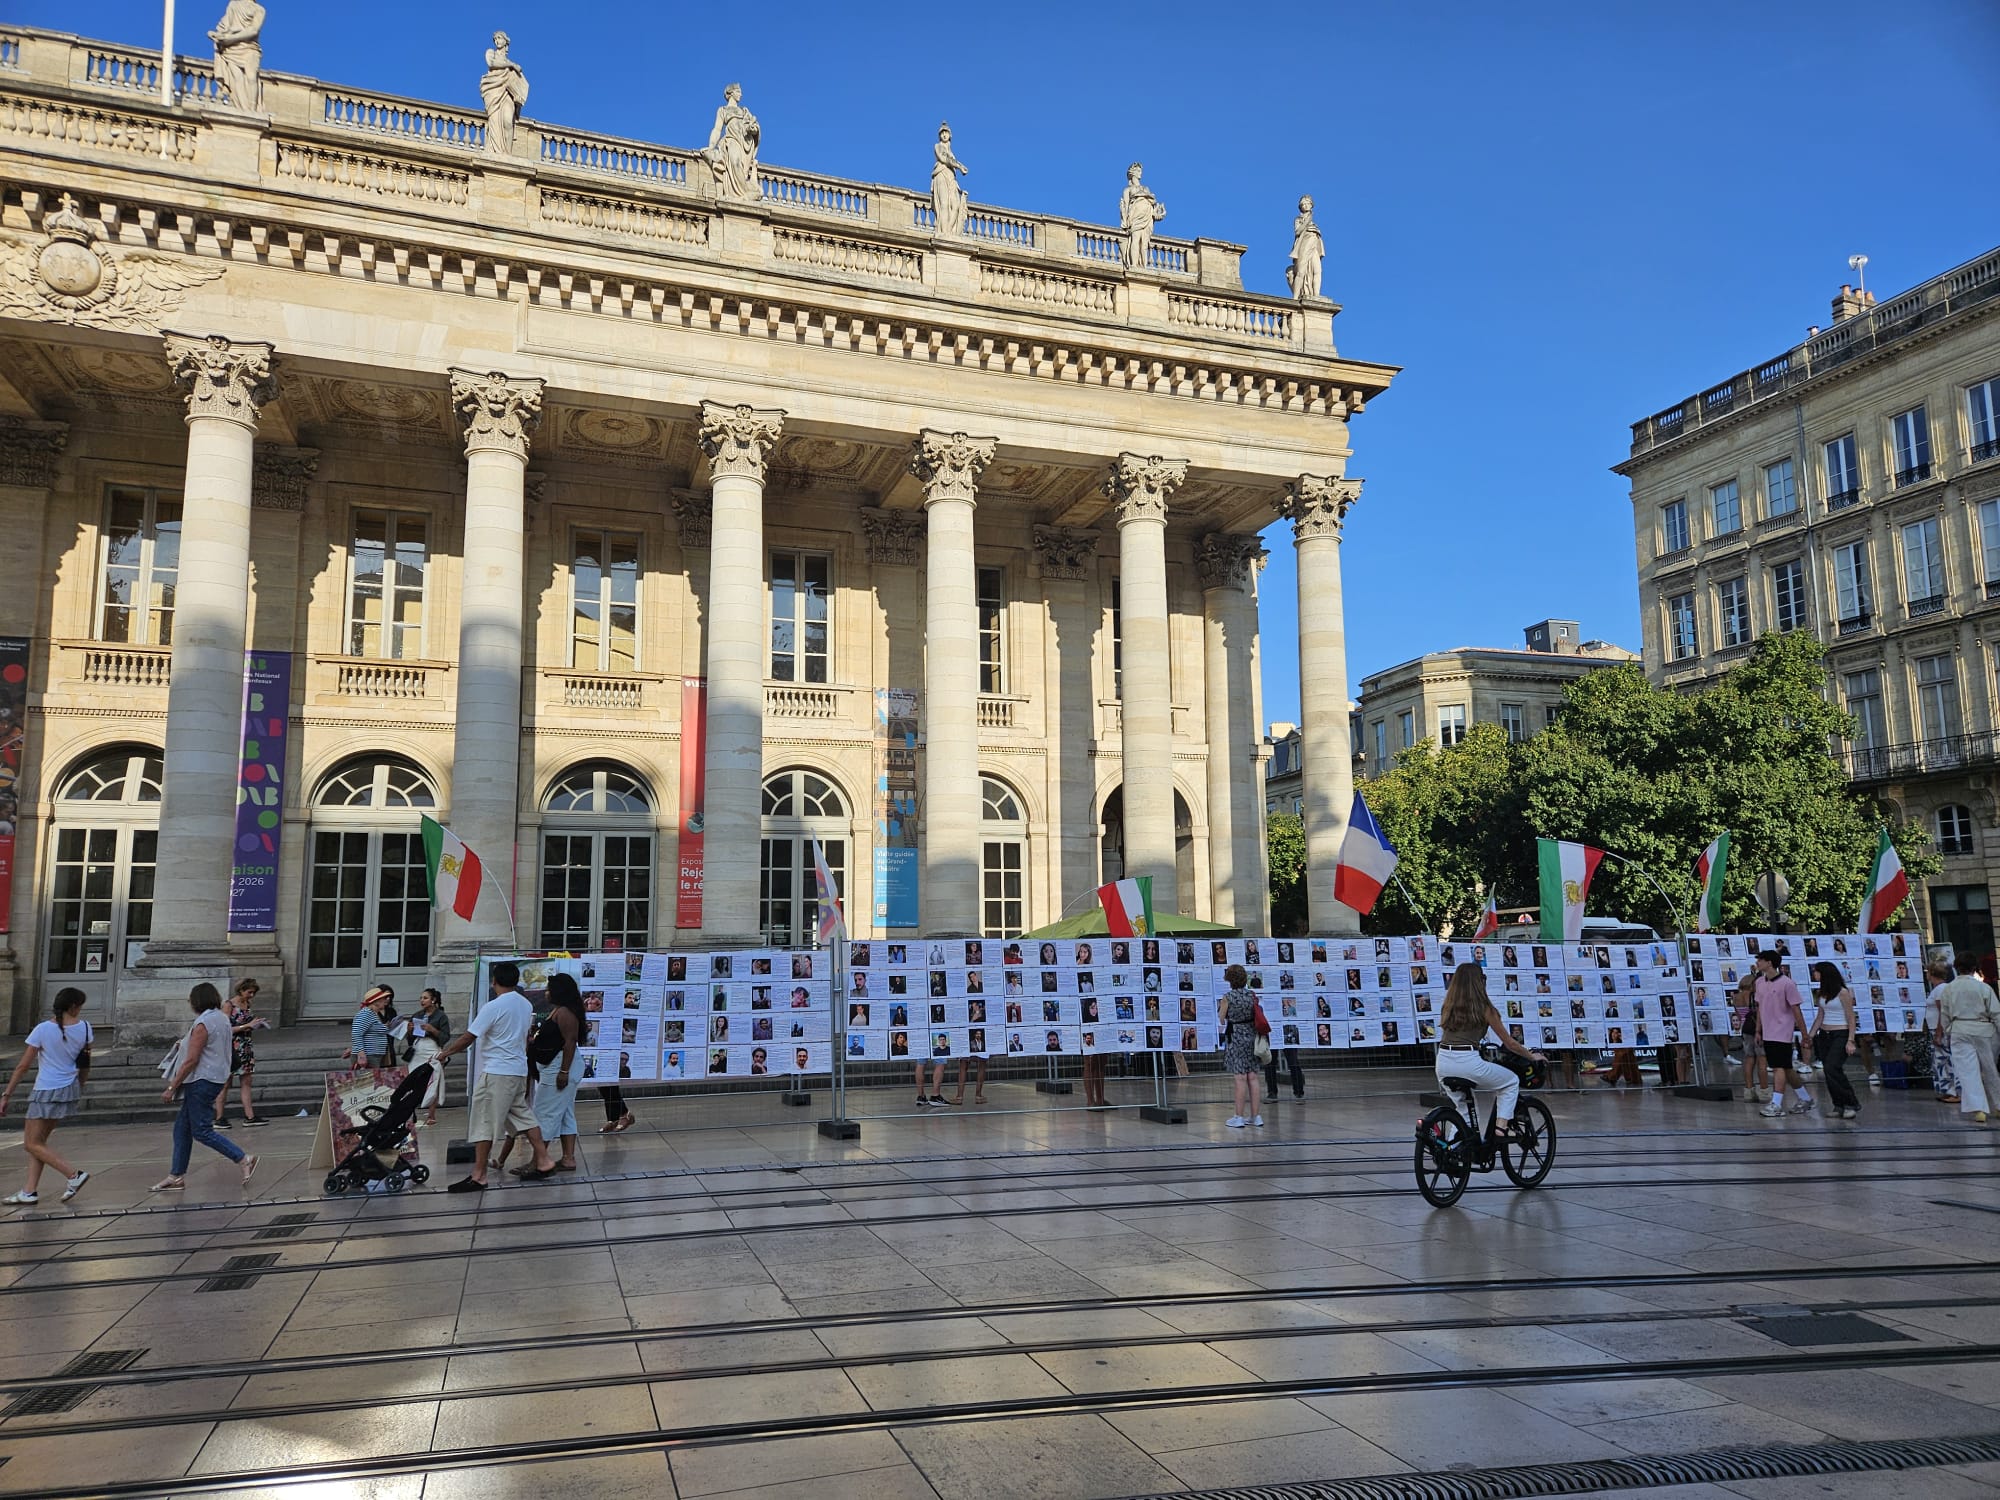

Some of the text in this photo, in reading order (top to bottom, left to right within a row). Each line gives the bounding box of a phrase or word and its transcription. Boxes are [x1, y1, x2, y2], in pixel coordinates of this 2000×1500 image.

[232, 863, 274, 875] aison
[681, 867, 704, 879] Rejo
[238, 877, 264, 886] 2026
[680, 880, 704, 890] le ré
[230, 888, 245, 897] 27
